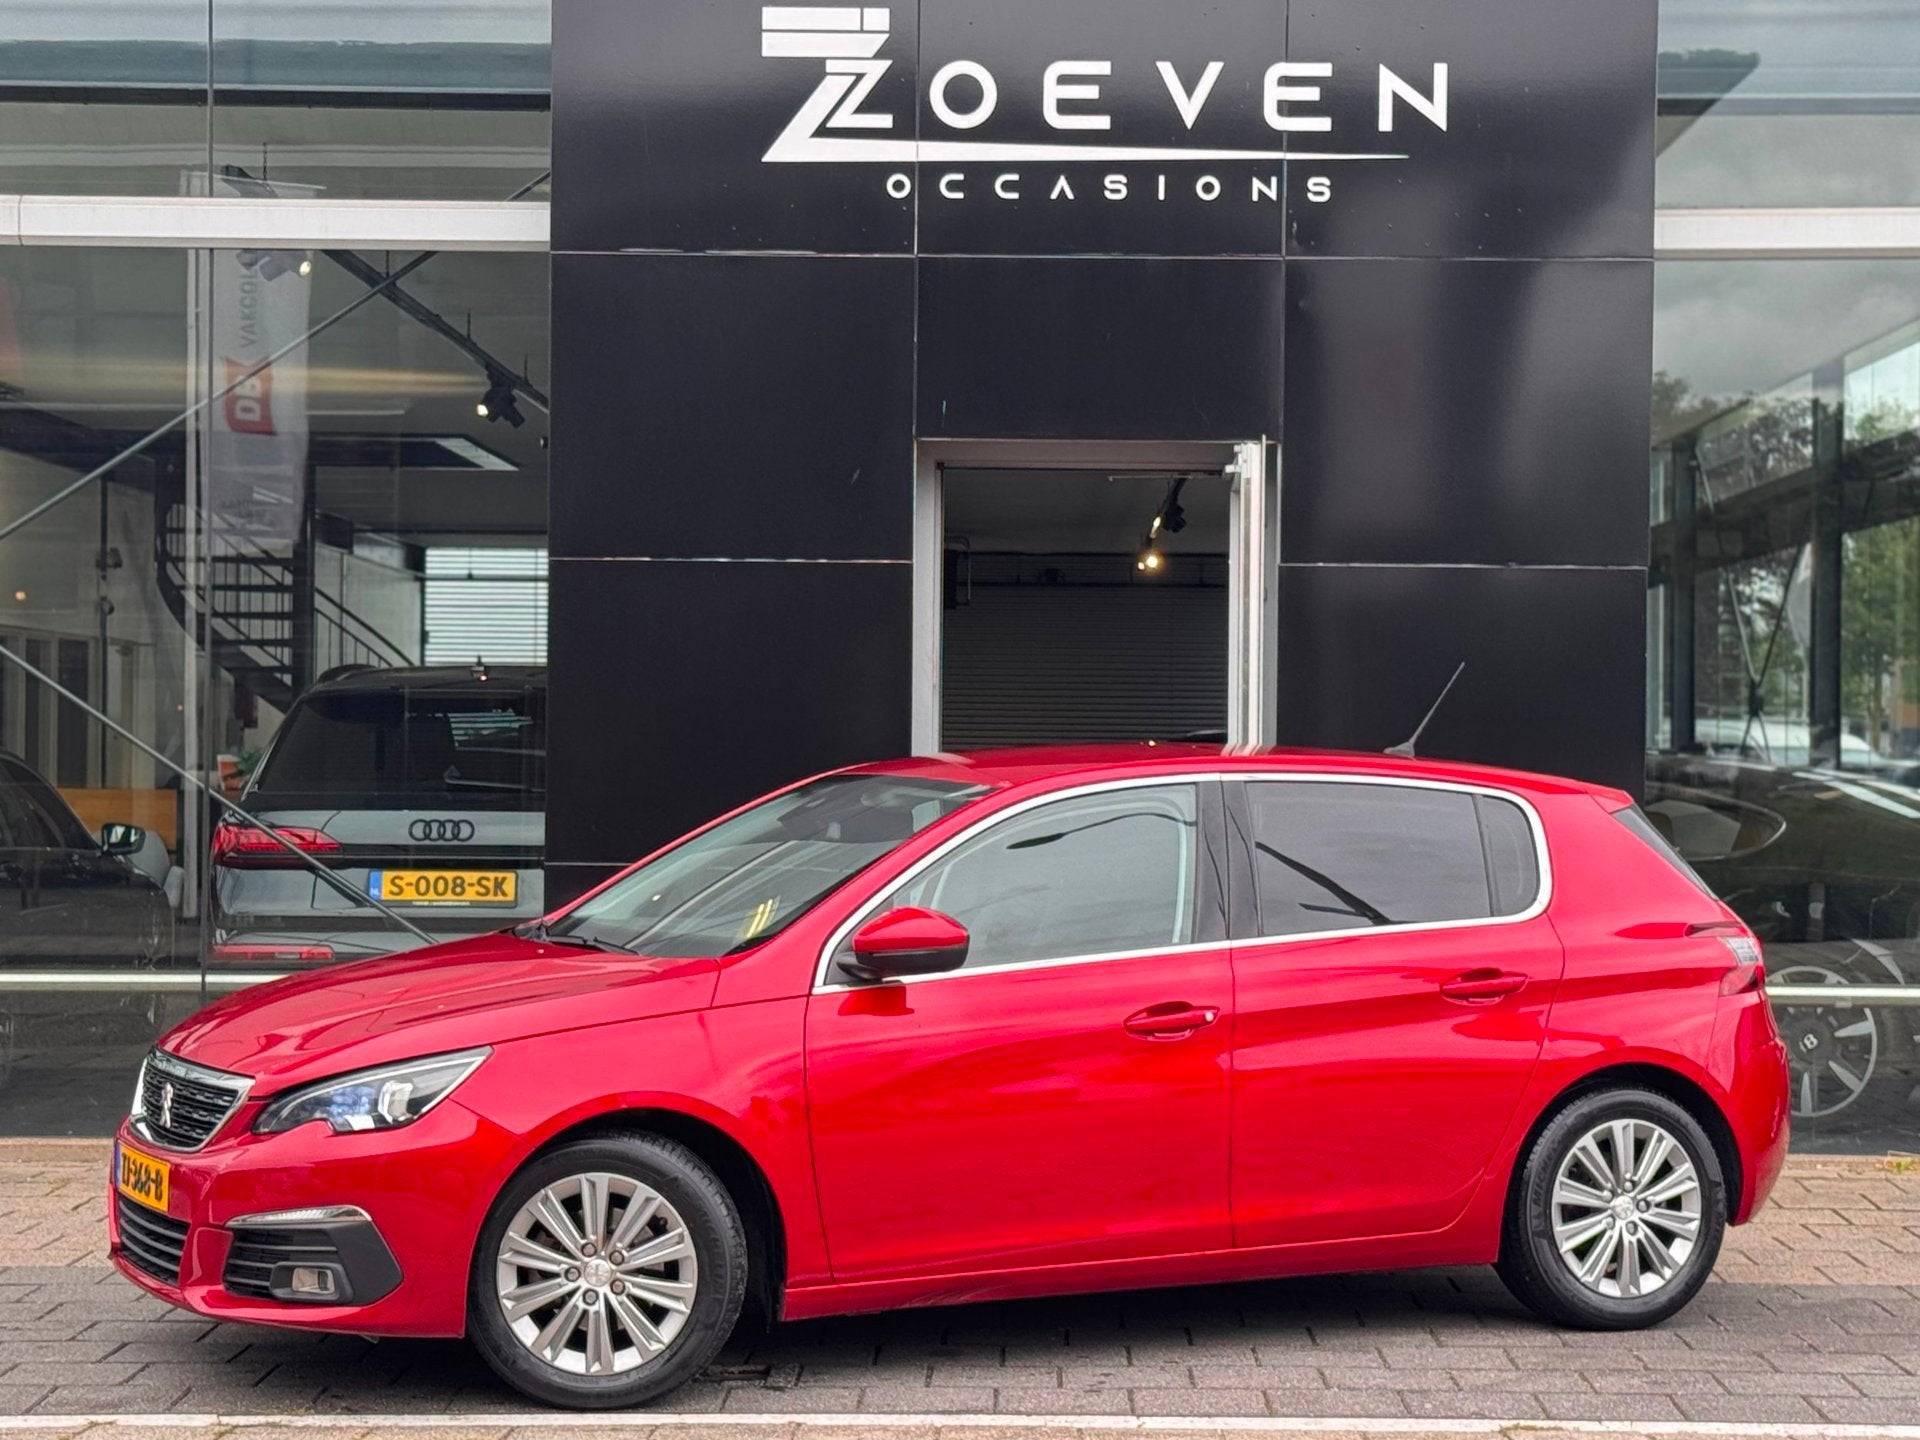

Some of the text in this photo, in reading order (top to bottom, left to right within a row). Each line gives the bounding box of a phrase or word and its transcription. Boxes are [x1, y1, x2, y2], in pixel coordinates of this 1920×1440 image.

[762, 7, 1448, 162] ZOEVEN
[886, 173, 1332, 203] OCCASIONS
[389, 875, 509, 897] S-008-SK
